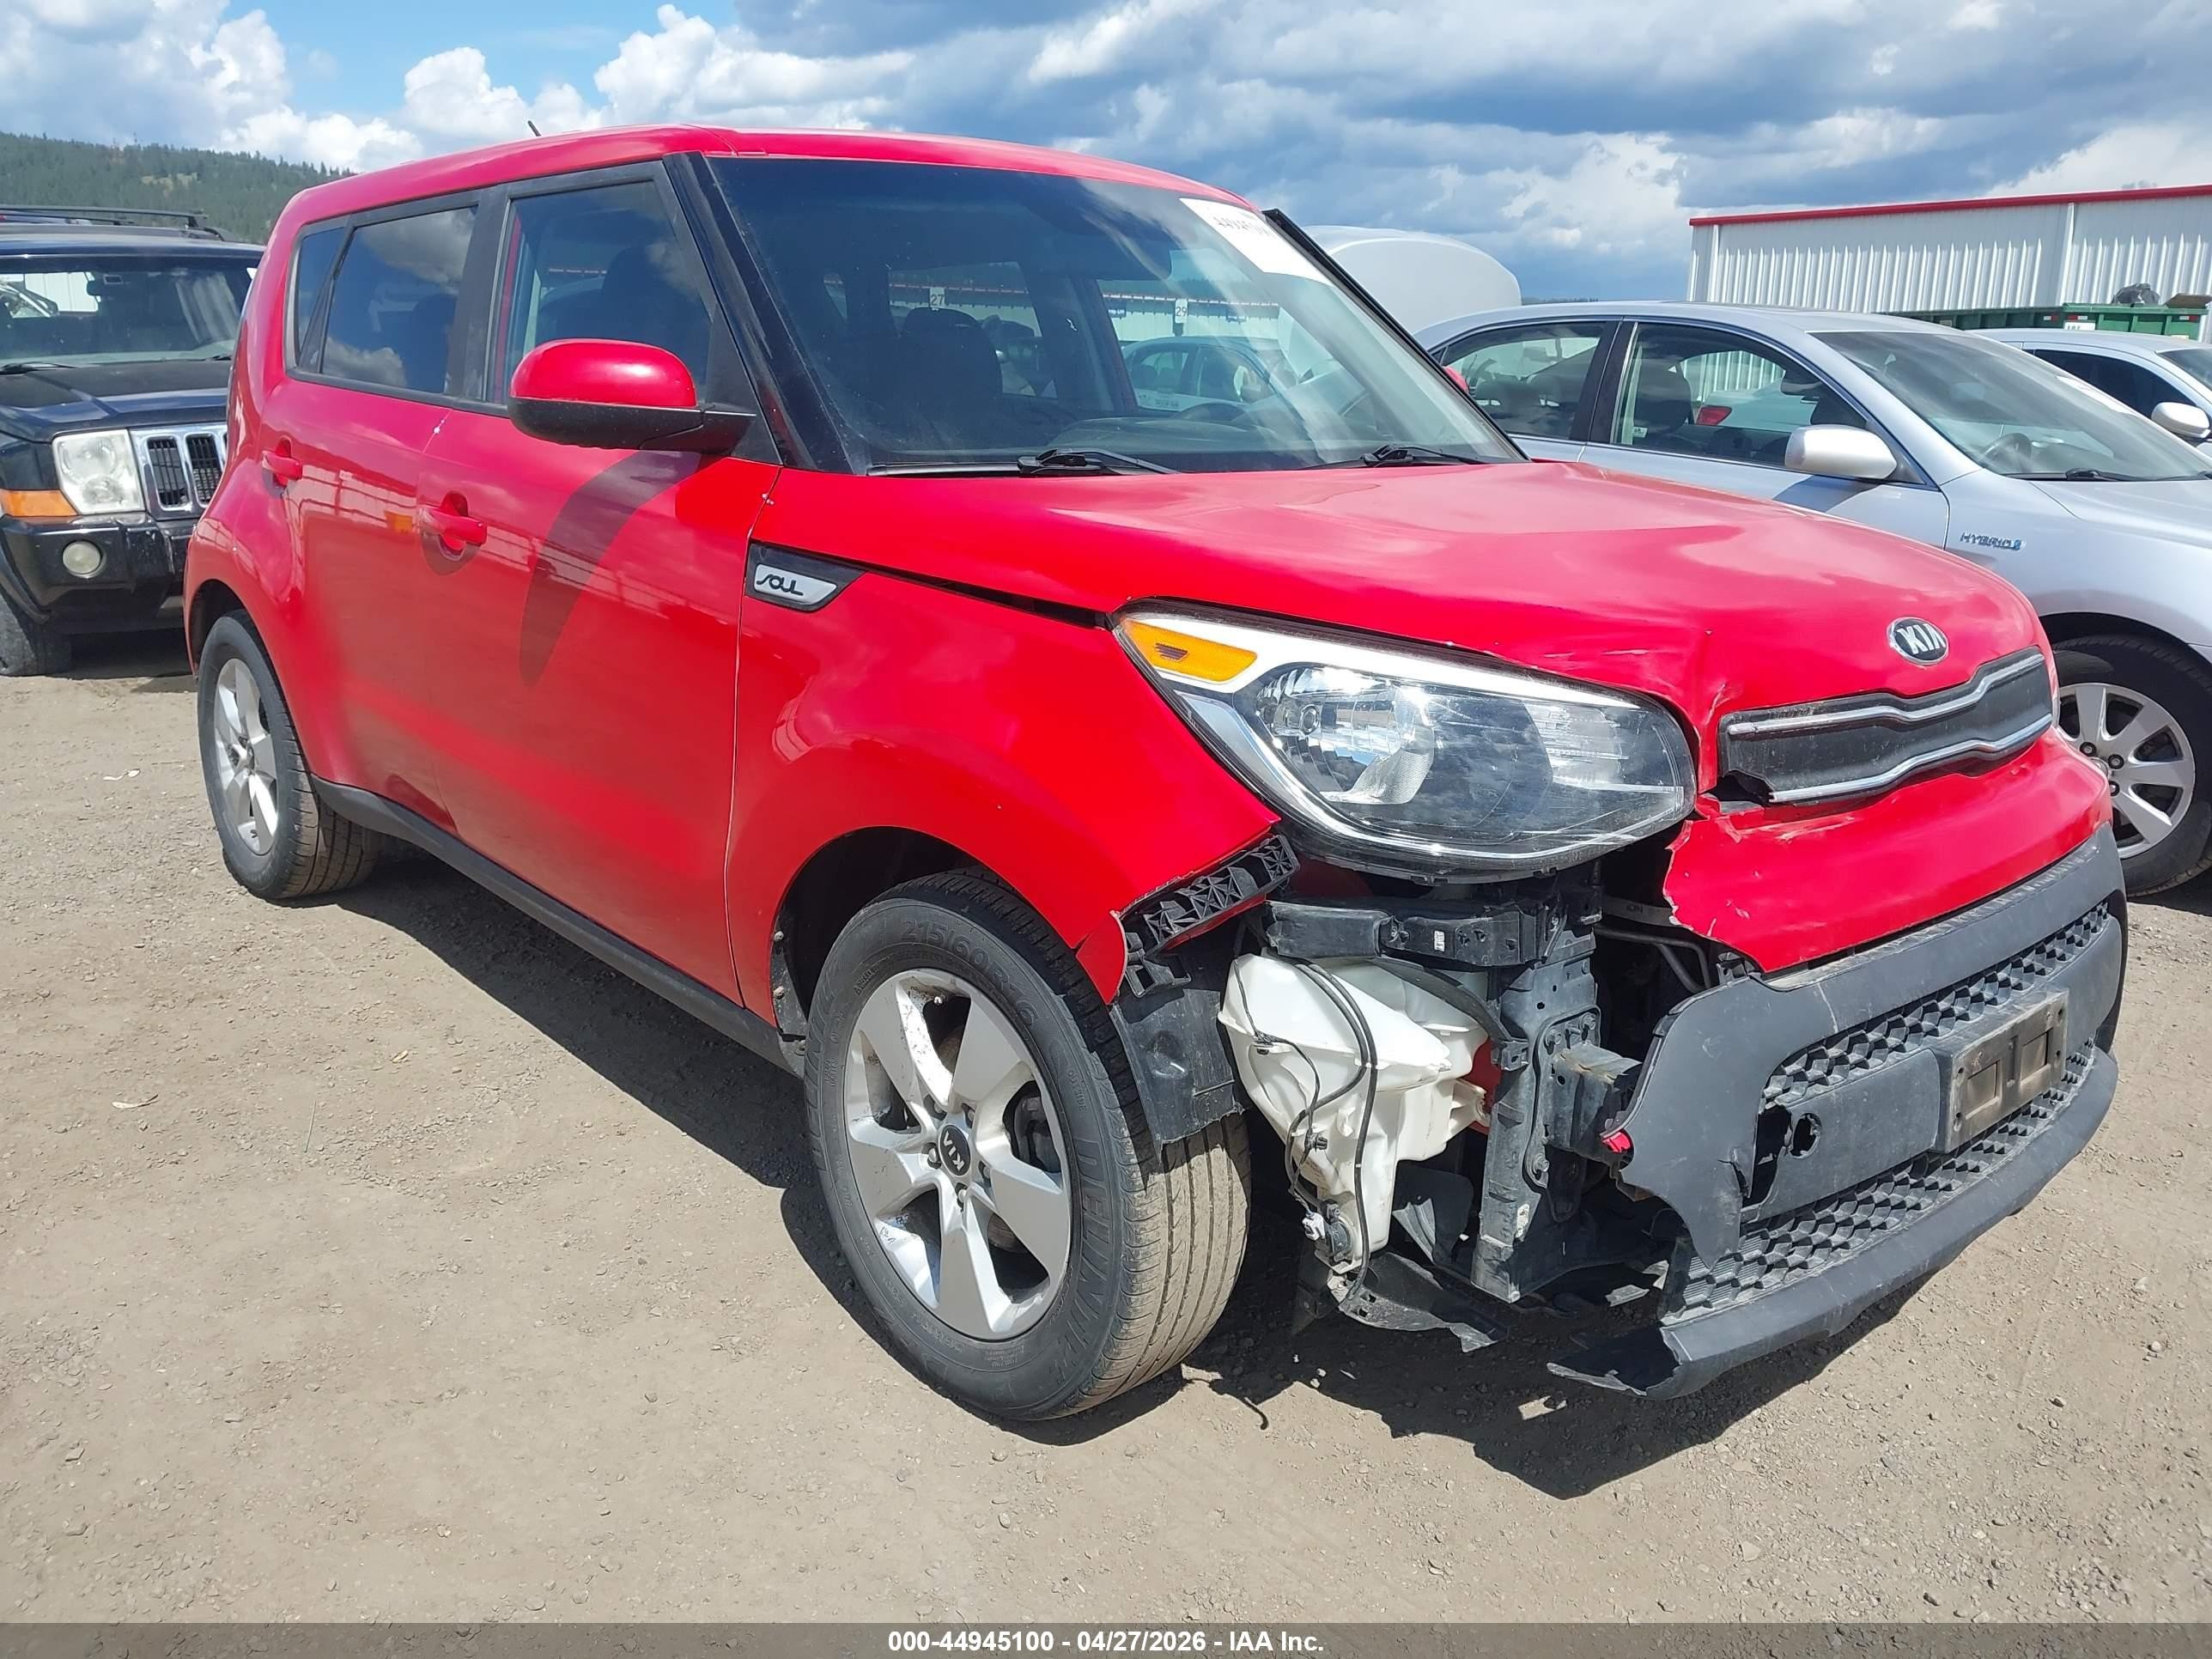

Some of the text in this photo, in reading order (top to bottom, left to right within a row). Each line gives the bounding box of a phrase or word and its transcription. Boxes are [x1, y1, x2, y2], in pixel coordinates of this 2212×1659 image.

[931, 294, 945, 306] 27
[1176, 306, 1188, 317] 29
[1960, 532, 2012, 548] HYBRID
[756, 573, 805, 597] SOUL
[1896, 623, 1947, 655] KIA
[943, 1130, 965, 1171] KIA
